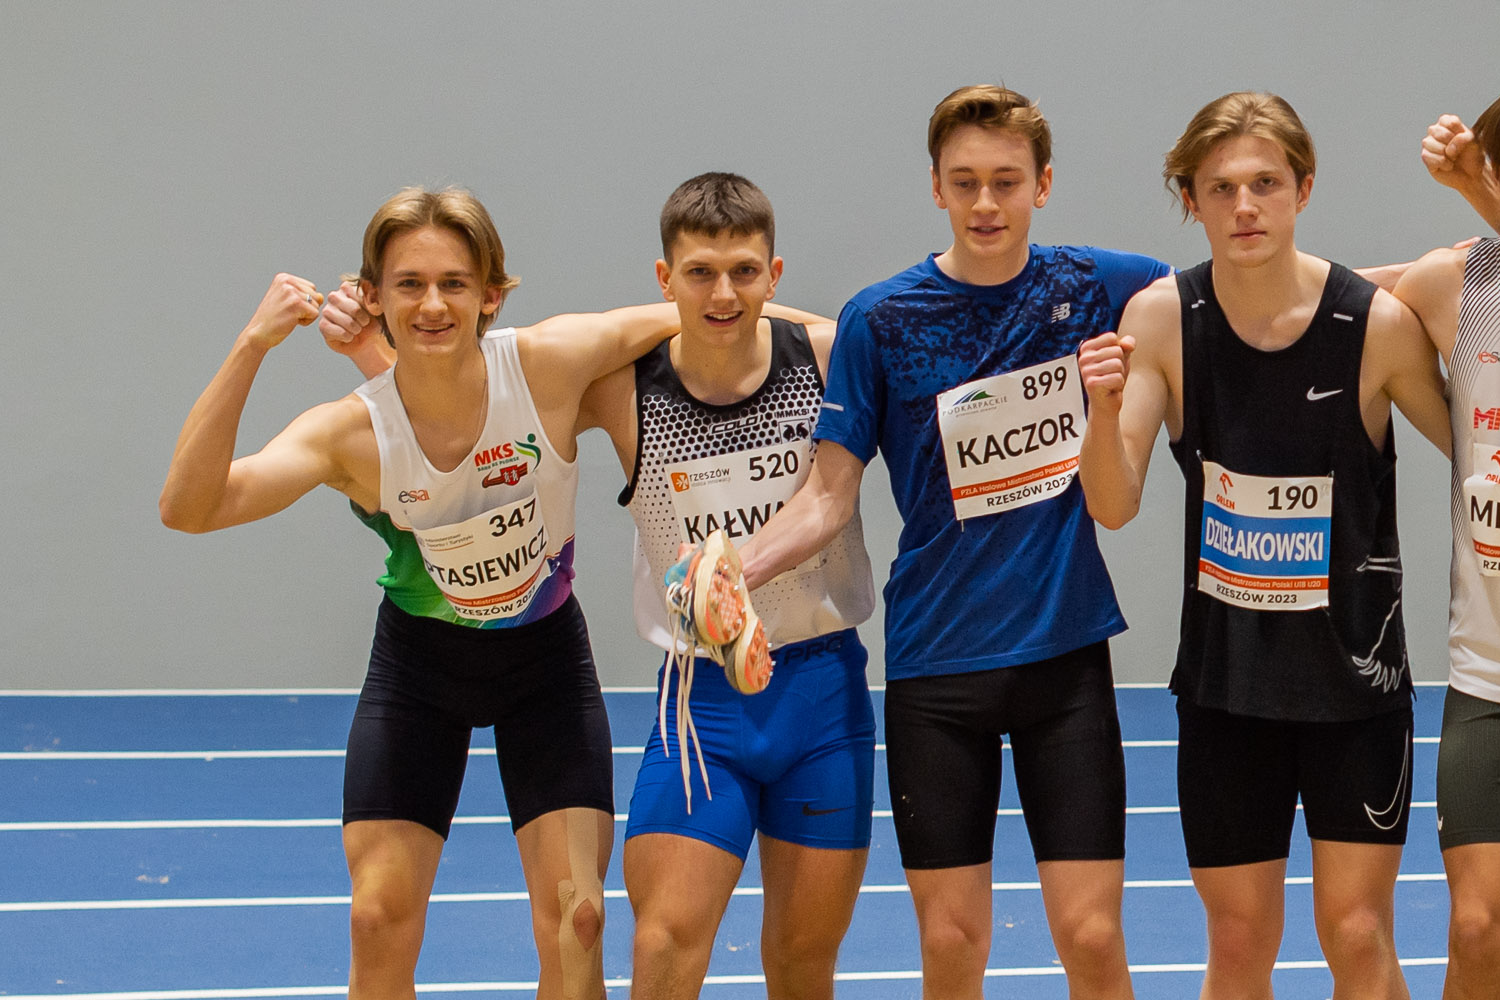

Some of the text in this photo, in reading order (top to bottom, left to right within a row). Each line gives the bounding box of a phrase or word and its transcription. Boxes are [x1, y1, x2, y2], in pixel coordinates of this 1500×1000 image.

[1022, 366, 1068, 400] 899
[775, 408, 808, 419] MMKS
[942, 396, 1008, 416] PODKARPACKIE
[957, 412, 1079, 469] KACZOR
[474, 442, 514, 467] MKS
[749, 450, 799, 481] 520
[690, 468, 730, 482] rzeszów
[398, 490, 430, 503] esa
[986, 473, 1073, 507] RZESZÓW 2023
[1216, 494, 1235, 510] ORLEN
[1267, 485, 1318, 510] 190
[489, 498, 536, 538] 347
[1205, 516, 1324, 562] DZIEŁAKOWSKI
[1216, 584, 1297, 604] RZESZÓW 2023
[1272, 580, 1293, 589] Polski
[455, 585, 536, 616] RZESZÓW 2023
